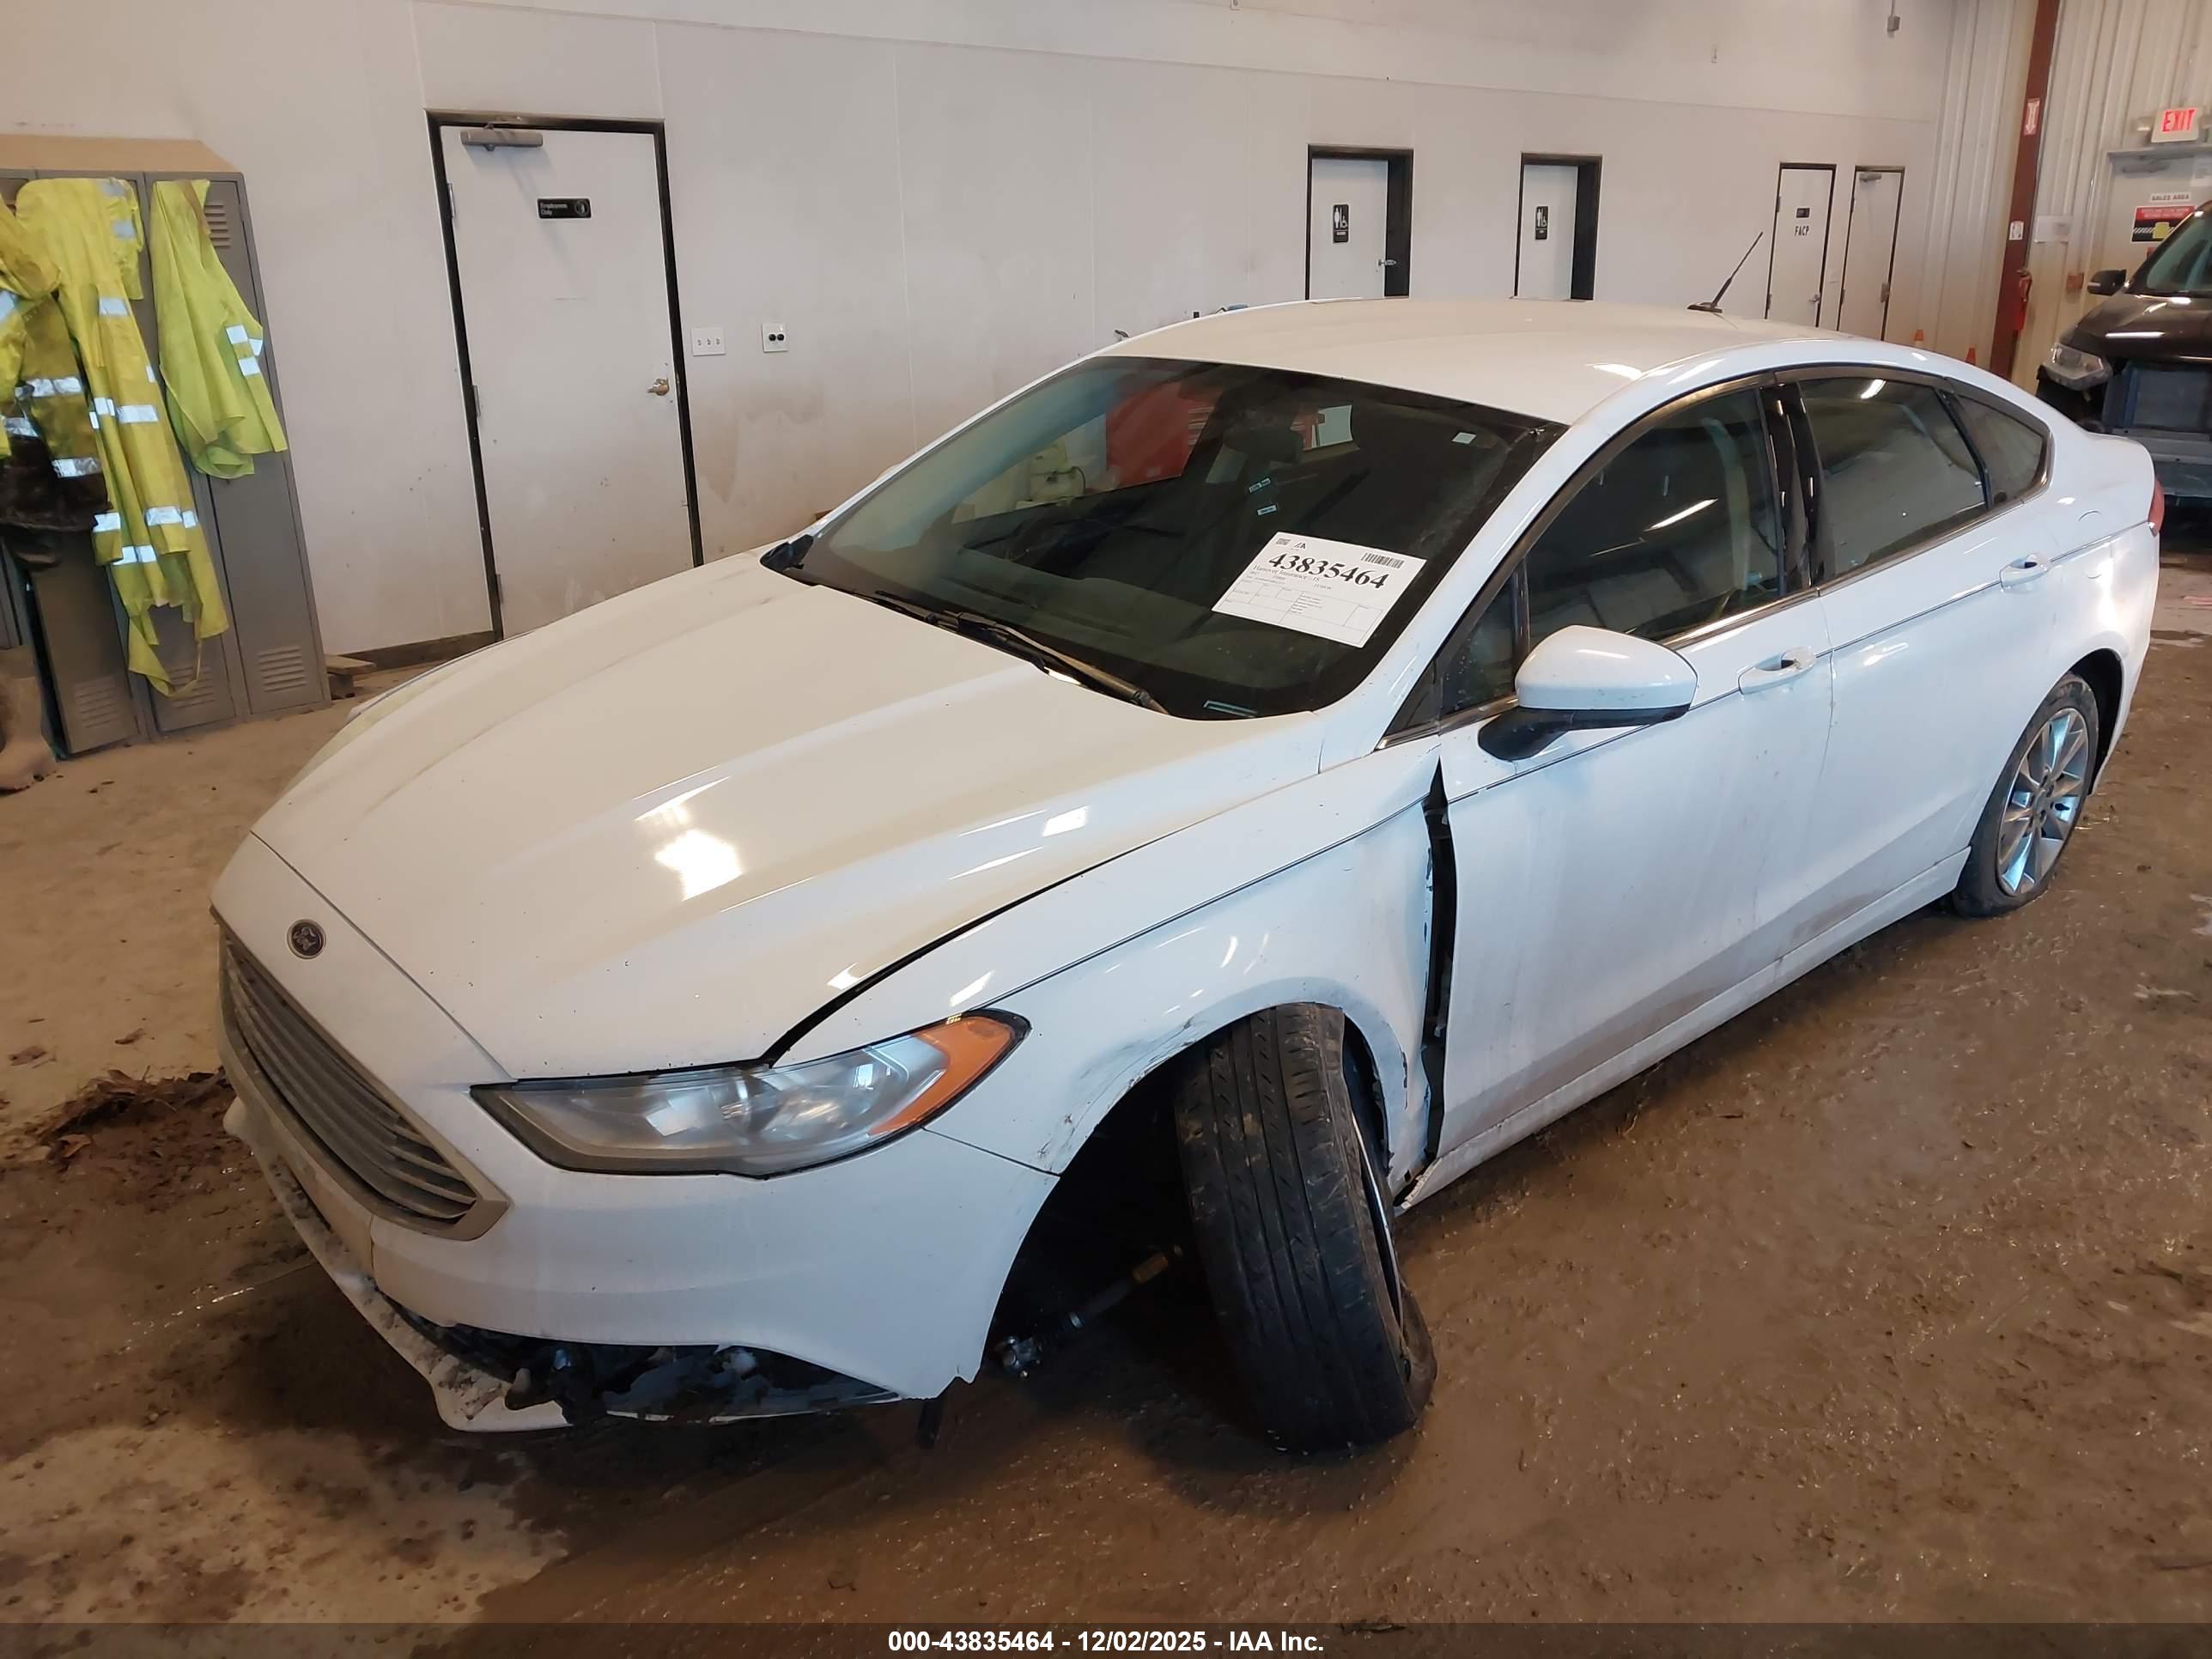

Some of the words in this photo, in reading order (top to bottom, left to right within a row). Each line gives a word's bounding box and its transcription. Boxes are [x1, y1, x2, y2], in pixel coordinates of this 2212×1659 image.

[2162, 109, 2195, 132] EXIT
[1795, 225, 1809, 236] FACP
[1269, 553, 1389, 589] 43835464
